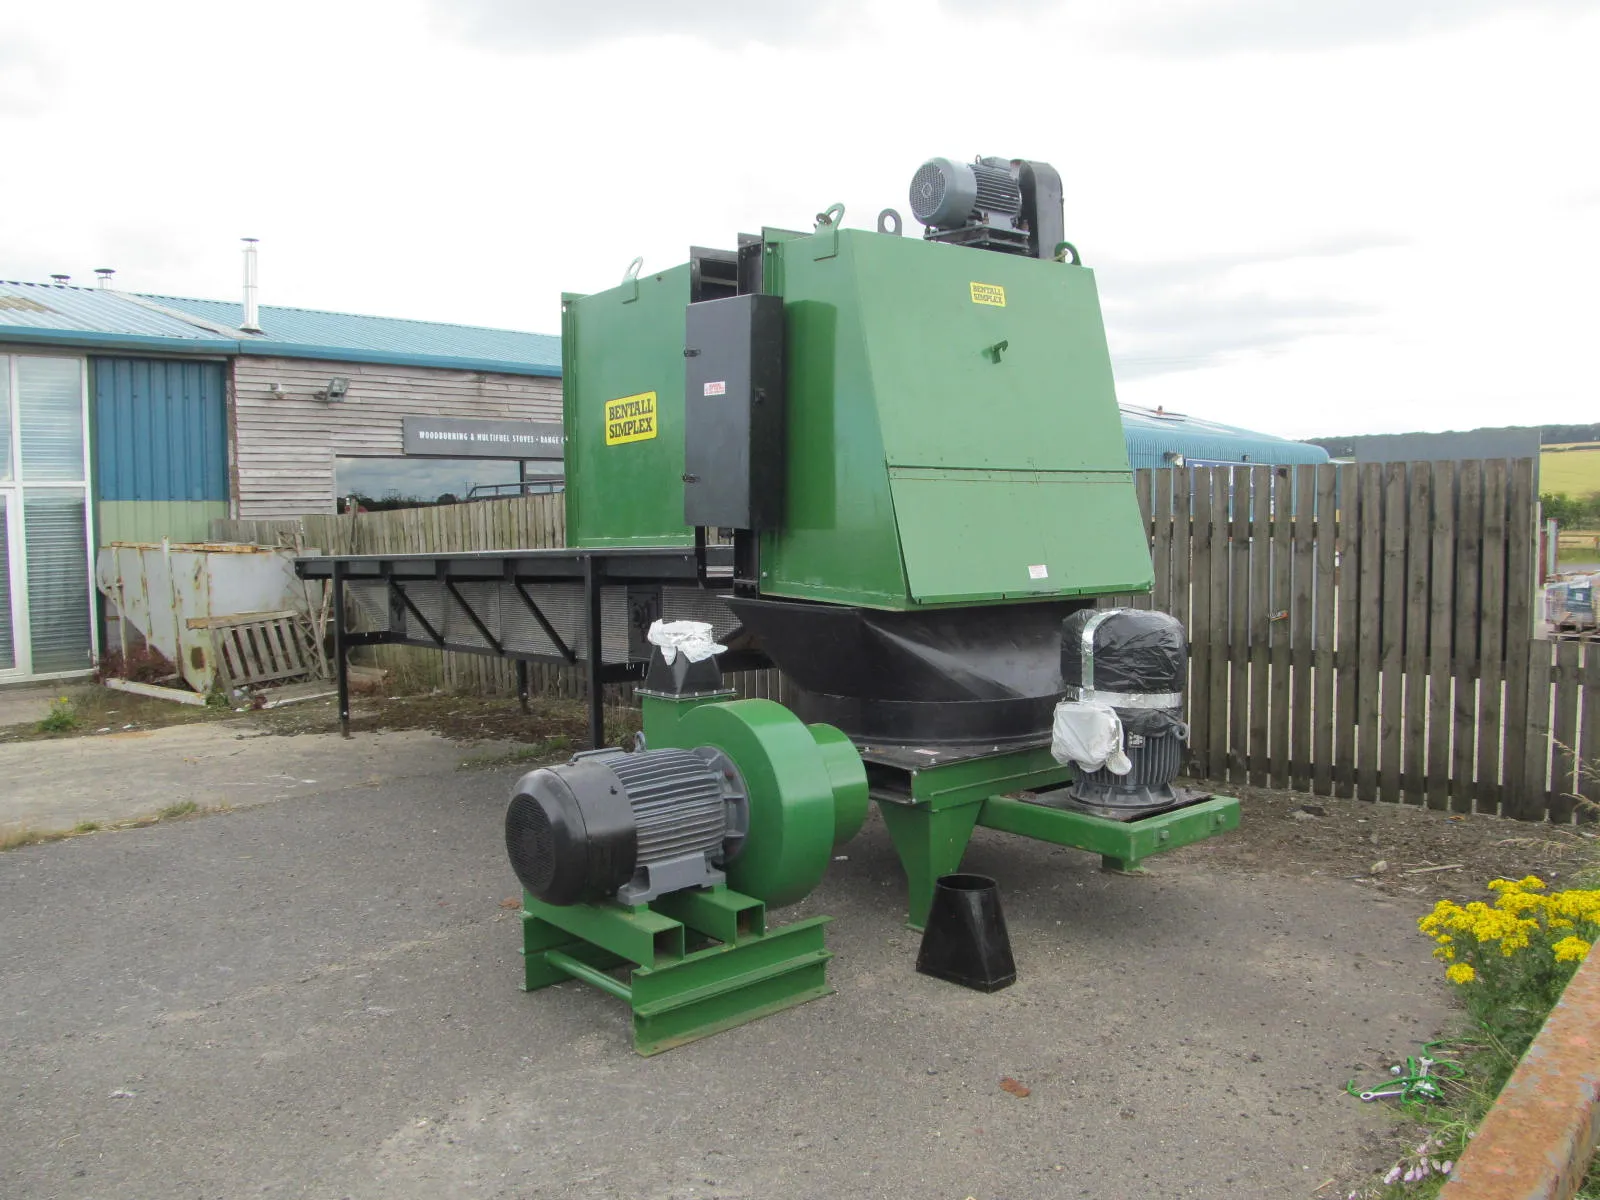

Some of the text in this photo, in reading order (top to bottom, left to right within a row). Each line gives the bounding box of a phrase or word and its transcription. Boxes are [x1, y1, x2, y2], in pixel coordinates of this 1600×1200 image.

[609, 398, 653, 421] BENTALL
[419, 431, 468, 441] WOODBURNING
[477, 433, 510, 443] MULTIFUEL
[512, 434, 534, 443] STOVES
[540, 435, 559, 444] RANGE
[609, 417, 652, 439] SIMPLEX
